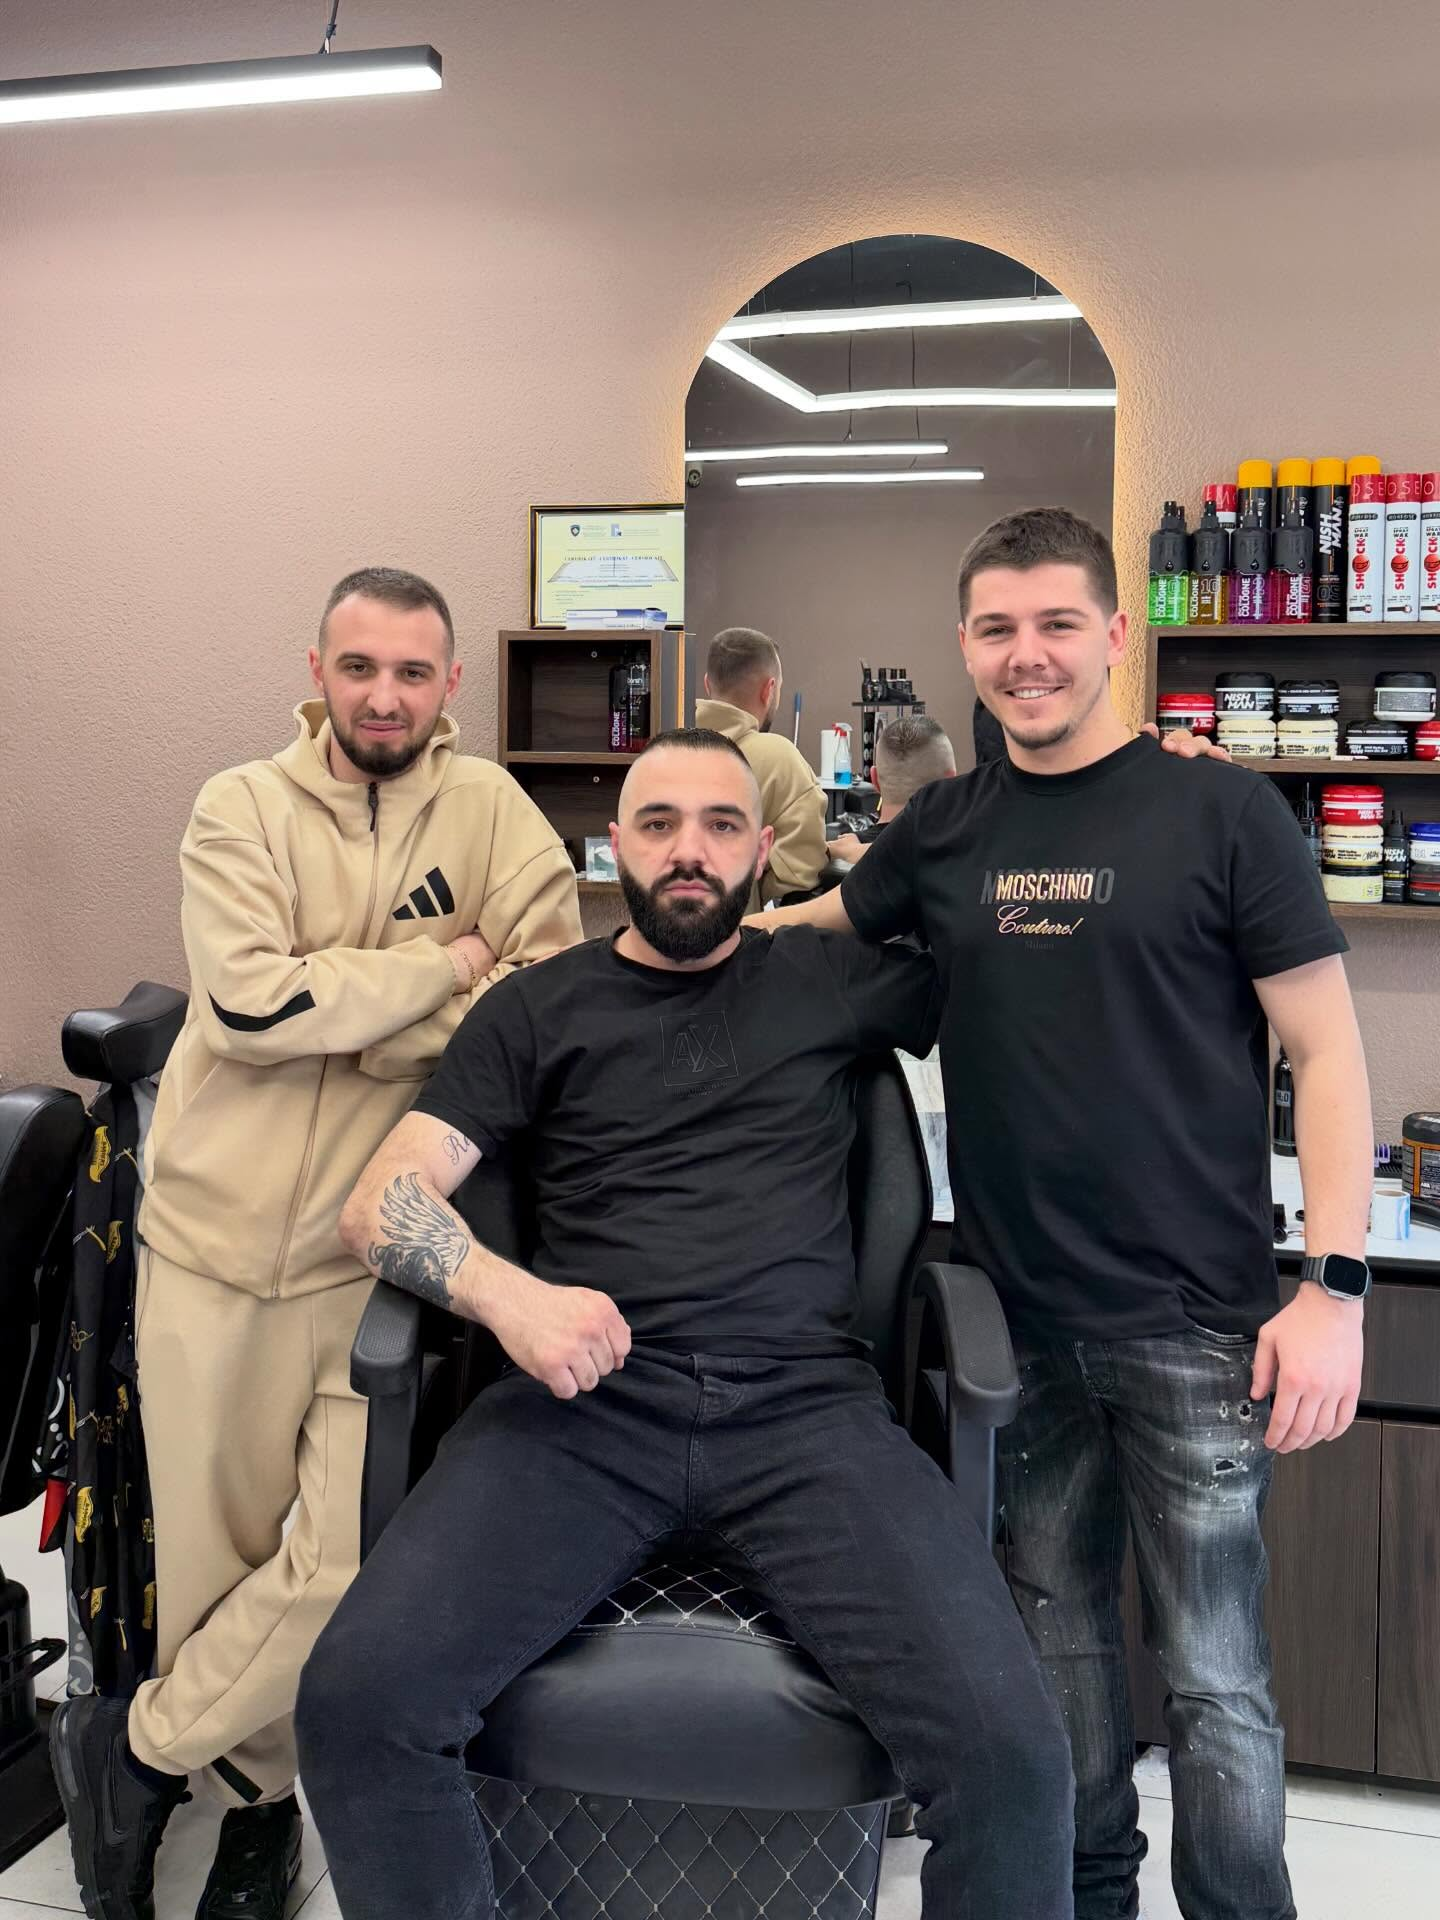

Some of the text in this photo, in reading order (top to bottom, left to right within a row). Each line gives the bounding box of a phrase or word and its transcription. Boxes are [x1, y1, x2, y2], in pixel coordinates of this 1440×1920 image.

[1319, 513, 1332, 555] NISH
[1331, 507, 1343, 549] MAN
[1191, 579, 1199, 618] COLOGNE
[1224, 693, 1251, 701] NISH
[1227, 700, 1255, 710] MAN
[1384, 848, 1404, 856] NISH
[1385, 854, 1407, 862] MAN
[995, 873, 1094, 901] MOSCHINO
[996, 904, 1085, 936] Couture!
